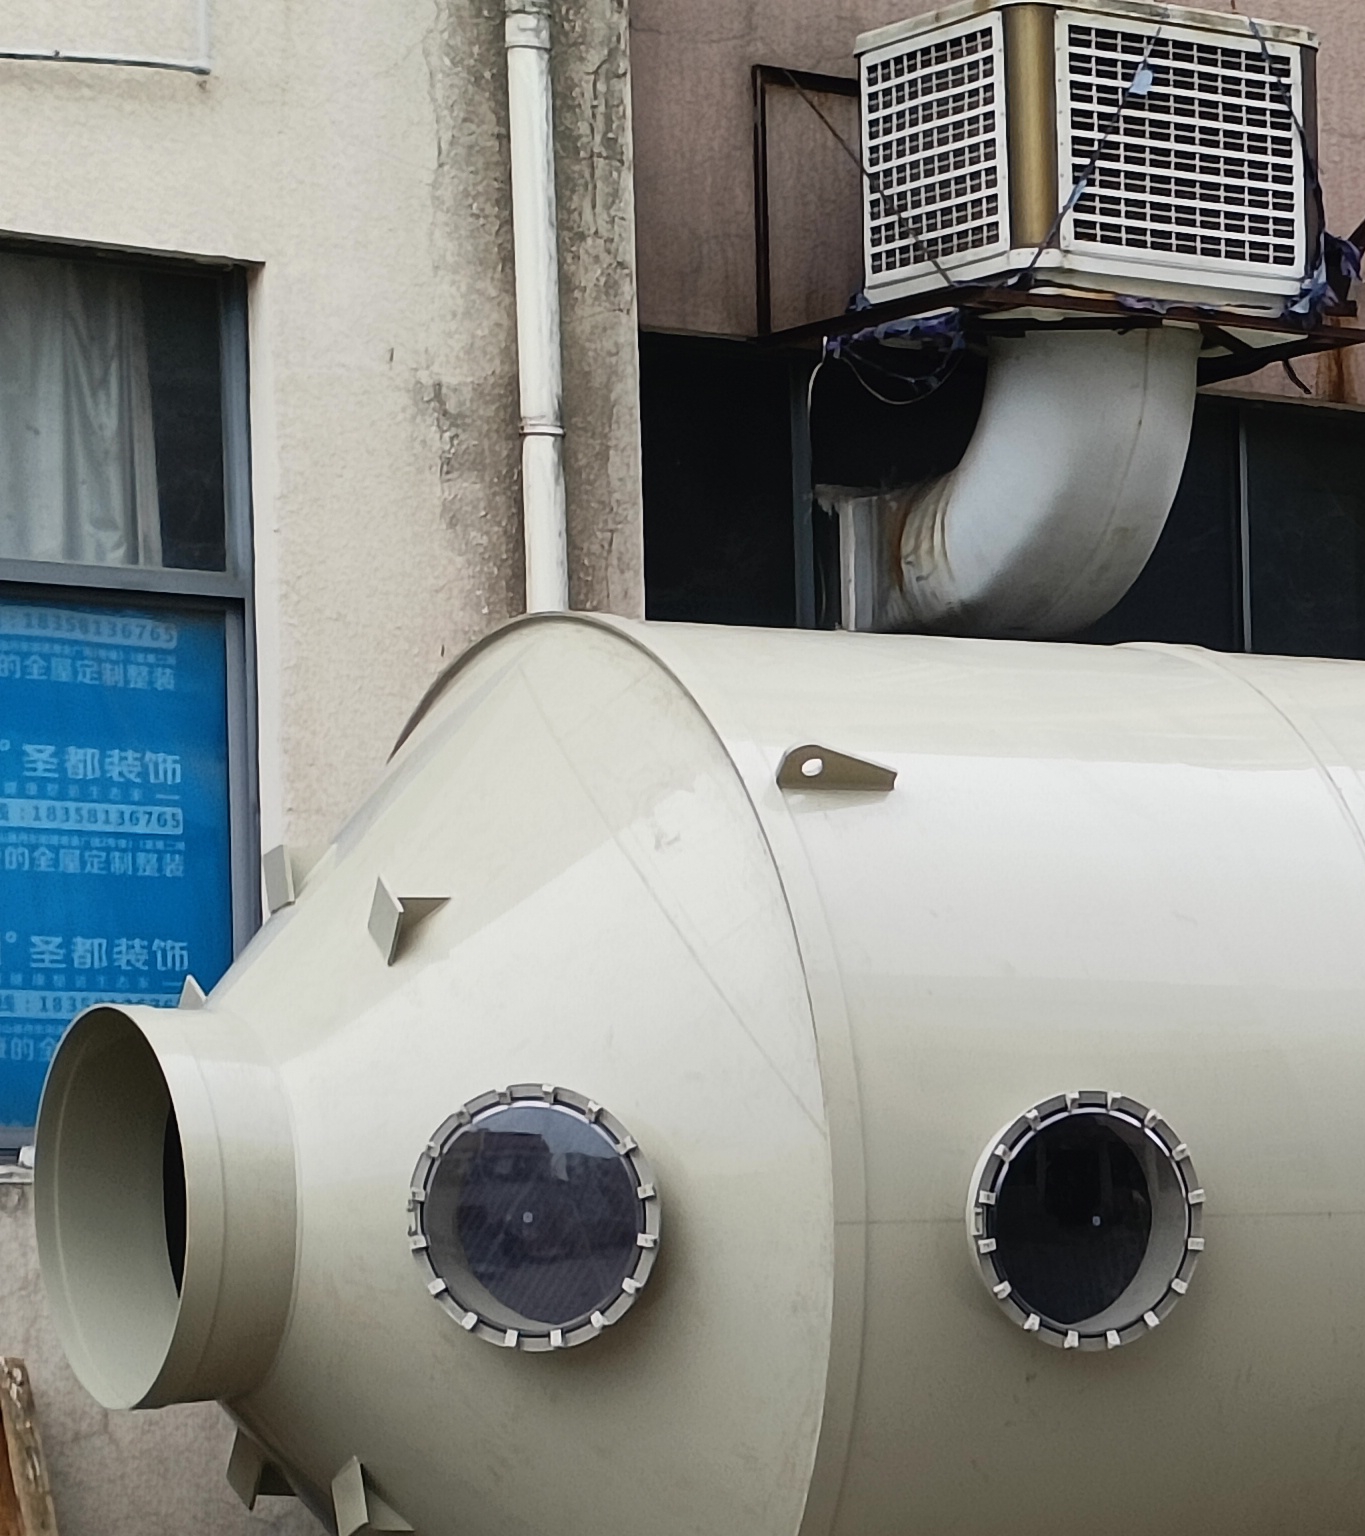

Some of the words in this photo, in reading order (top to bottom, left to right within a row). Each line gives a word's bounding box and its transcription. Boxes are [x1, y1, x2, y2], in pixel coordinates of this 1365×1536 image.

[22, 743, 183, 786] 圣都装饰
[30, 934, 190, 973] 圣都装饰
